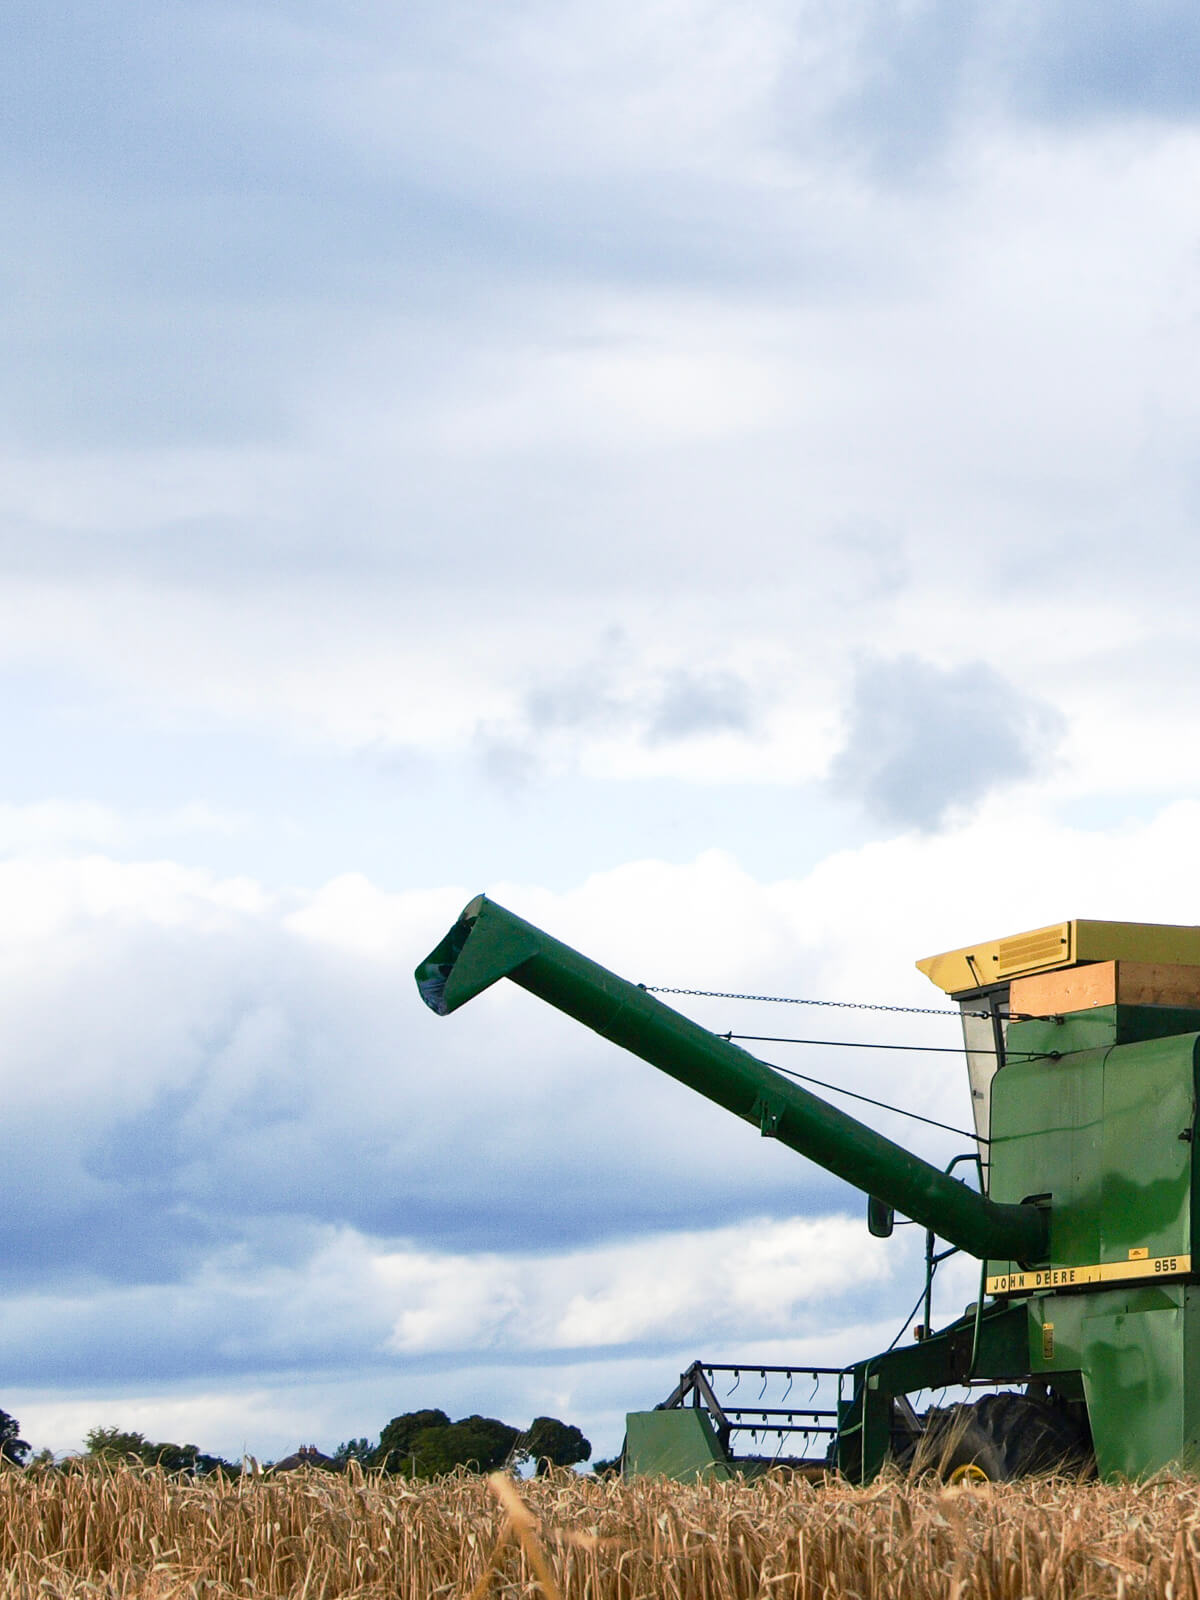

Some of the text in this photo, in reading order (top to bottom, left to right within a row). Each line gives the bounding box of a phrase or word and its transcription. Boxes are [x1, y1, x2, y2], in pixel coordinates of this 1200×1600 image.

[994, 1259, 1177, 1290] JOHN DEERE 955
